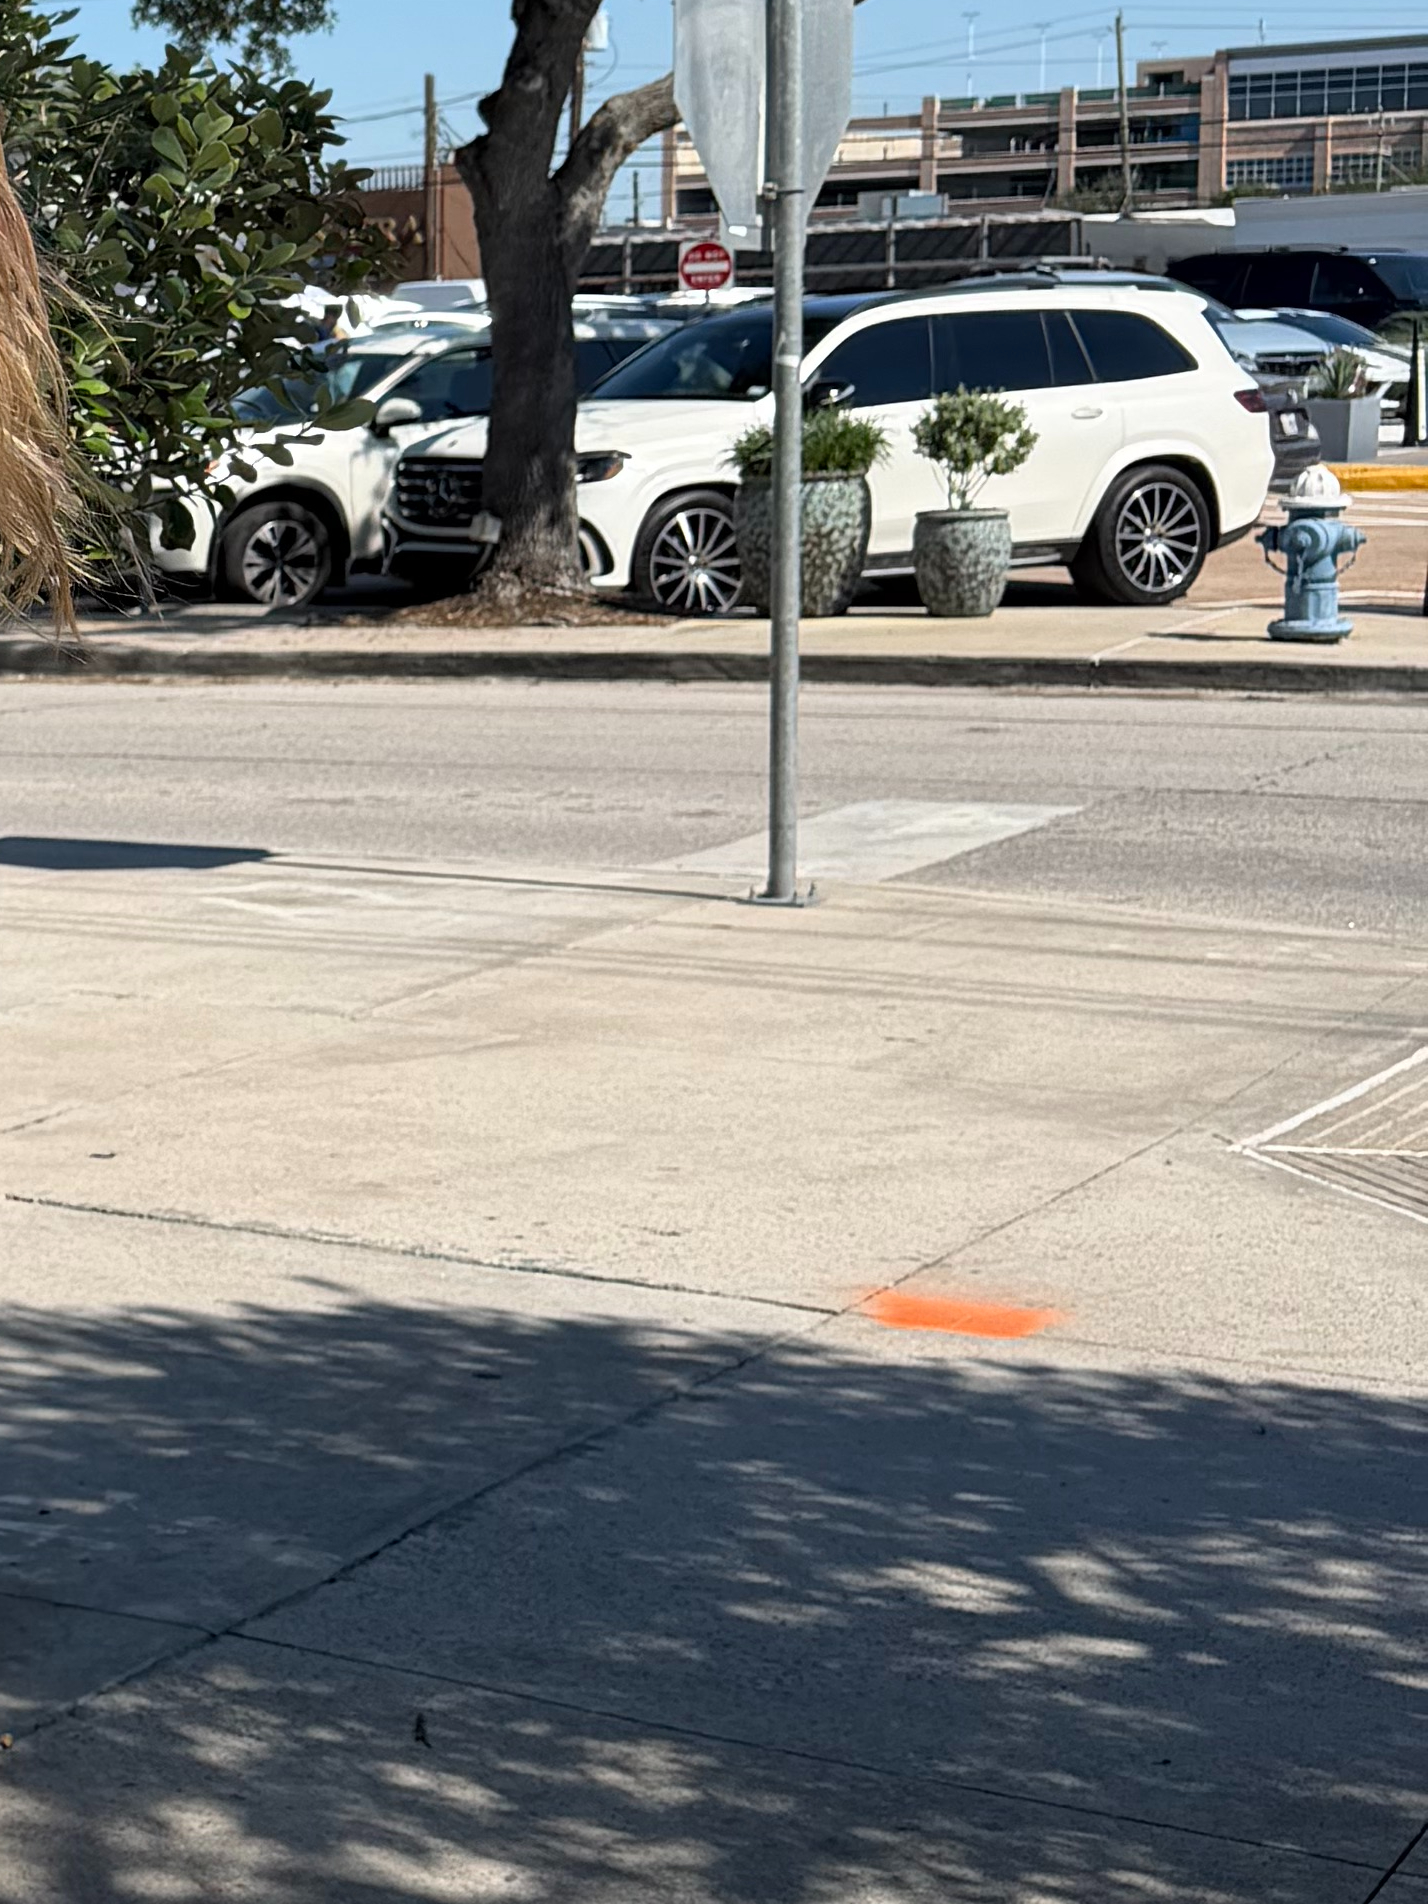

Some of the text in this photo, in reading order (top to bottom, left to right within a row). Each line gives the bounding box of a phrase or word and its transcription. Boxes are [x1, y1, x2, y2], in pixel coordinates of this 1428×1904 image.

[687, 249, 725, 261] DO NOT
[690, 274, 721, 284] ENTER
